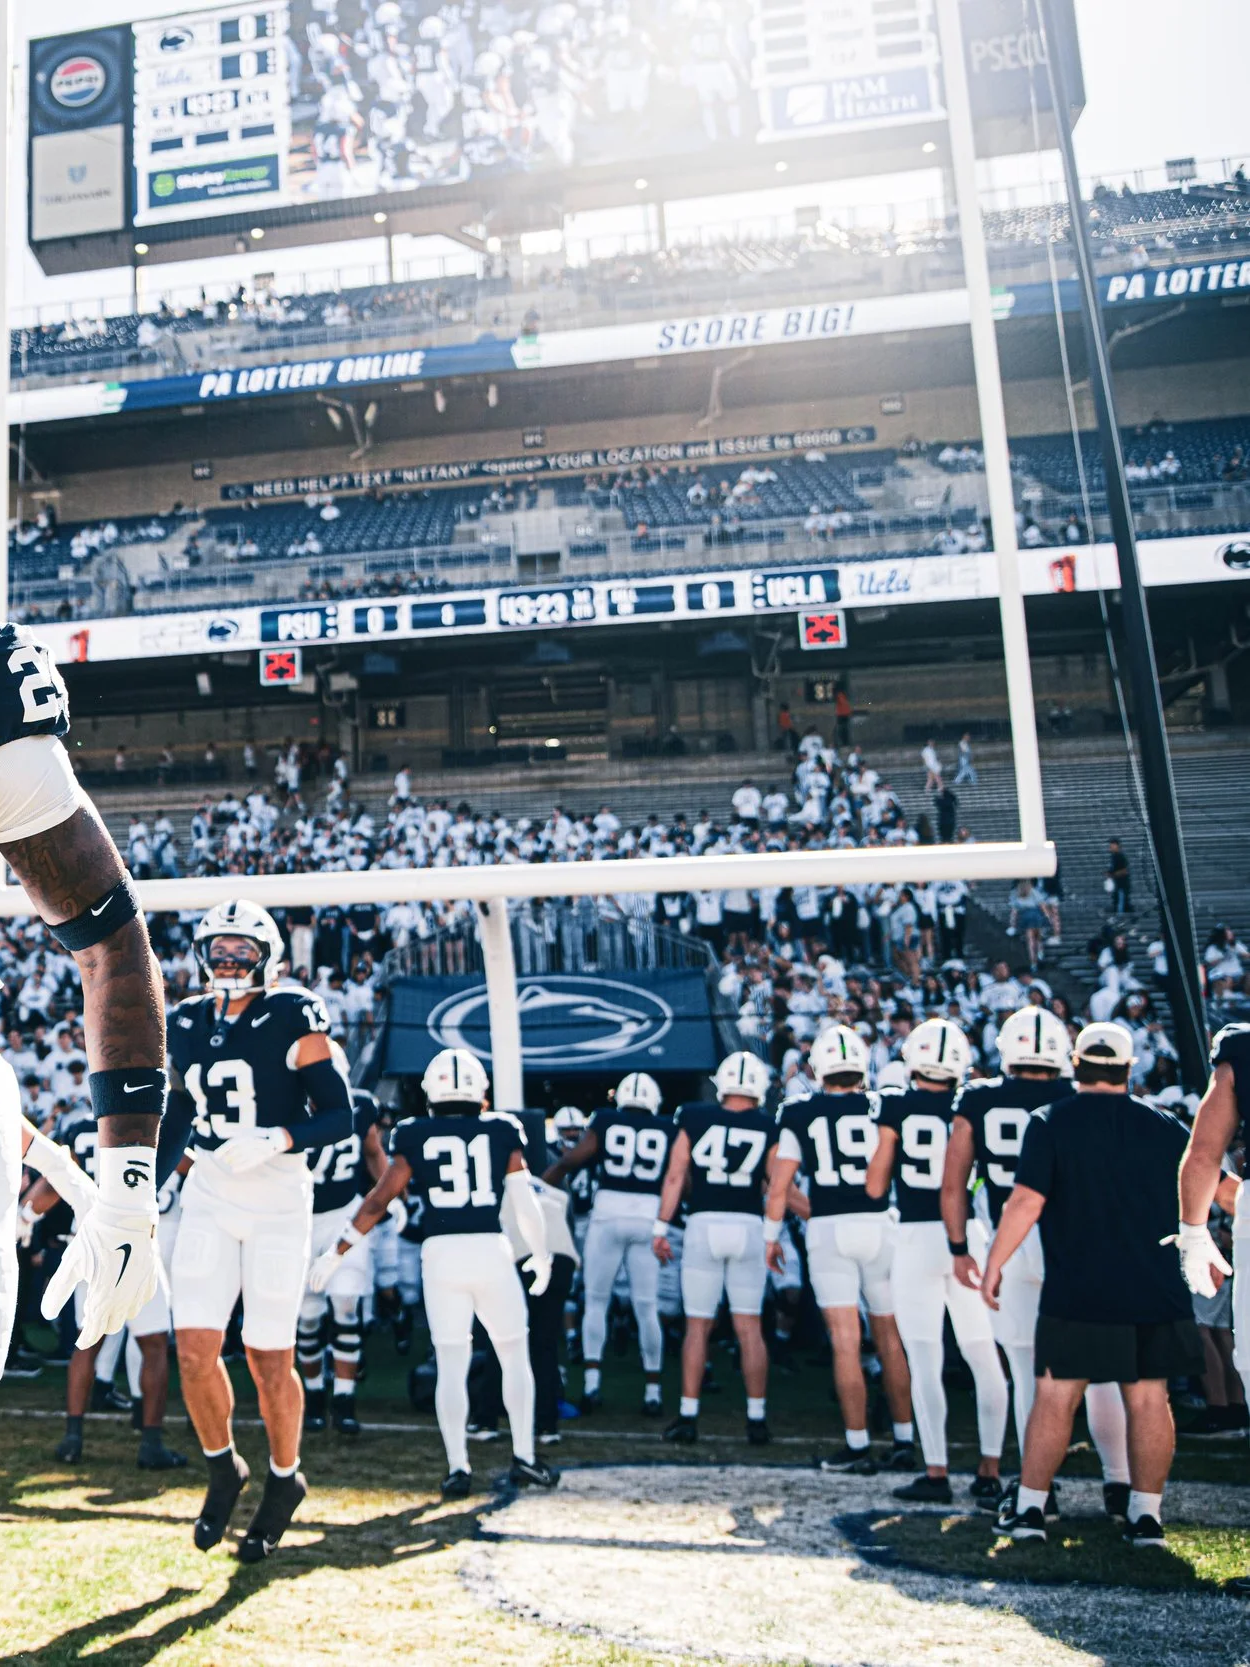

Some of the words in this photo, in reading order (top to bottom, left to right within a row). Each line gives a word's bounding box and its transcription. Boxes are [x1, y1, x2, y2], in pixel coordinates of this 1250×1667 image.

[832, 75, 888, 97] PAM
[1106, 273, 1146, 302] PA
[658, 312, 767, 350] SCORE
[783, 305, 855, 337] BIG!
[199, 373, 232, 399] PA
[236, 360, 334, 395] LOTTERY
[336, 350, 427, 383] ONLINE
[252, 480, 295, 498] NEED
[353, 470, 392, 488] TEXT
[546, 451, 593, 470] YOUR
[597, 443, 681, 465] LOCATION
[686, 442, 714, 458] and
[718, 438, 771, 456] ISSUE
[766, 573, 827, 607] UCLA
[278, 610, 322, 641] PSU
[302, 1002, 331, 1032] 13
[184, 1058, 257, 1140] 13
[423, 1134, 498, 1208] 31
[604, 1124, 668, 1181] 99
[691, 1124, 767, 1187] 47
[807, 1114, 879, 1187] 19
